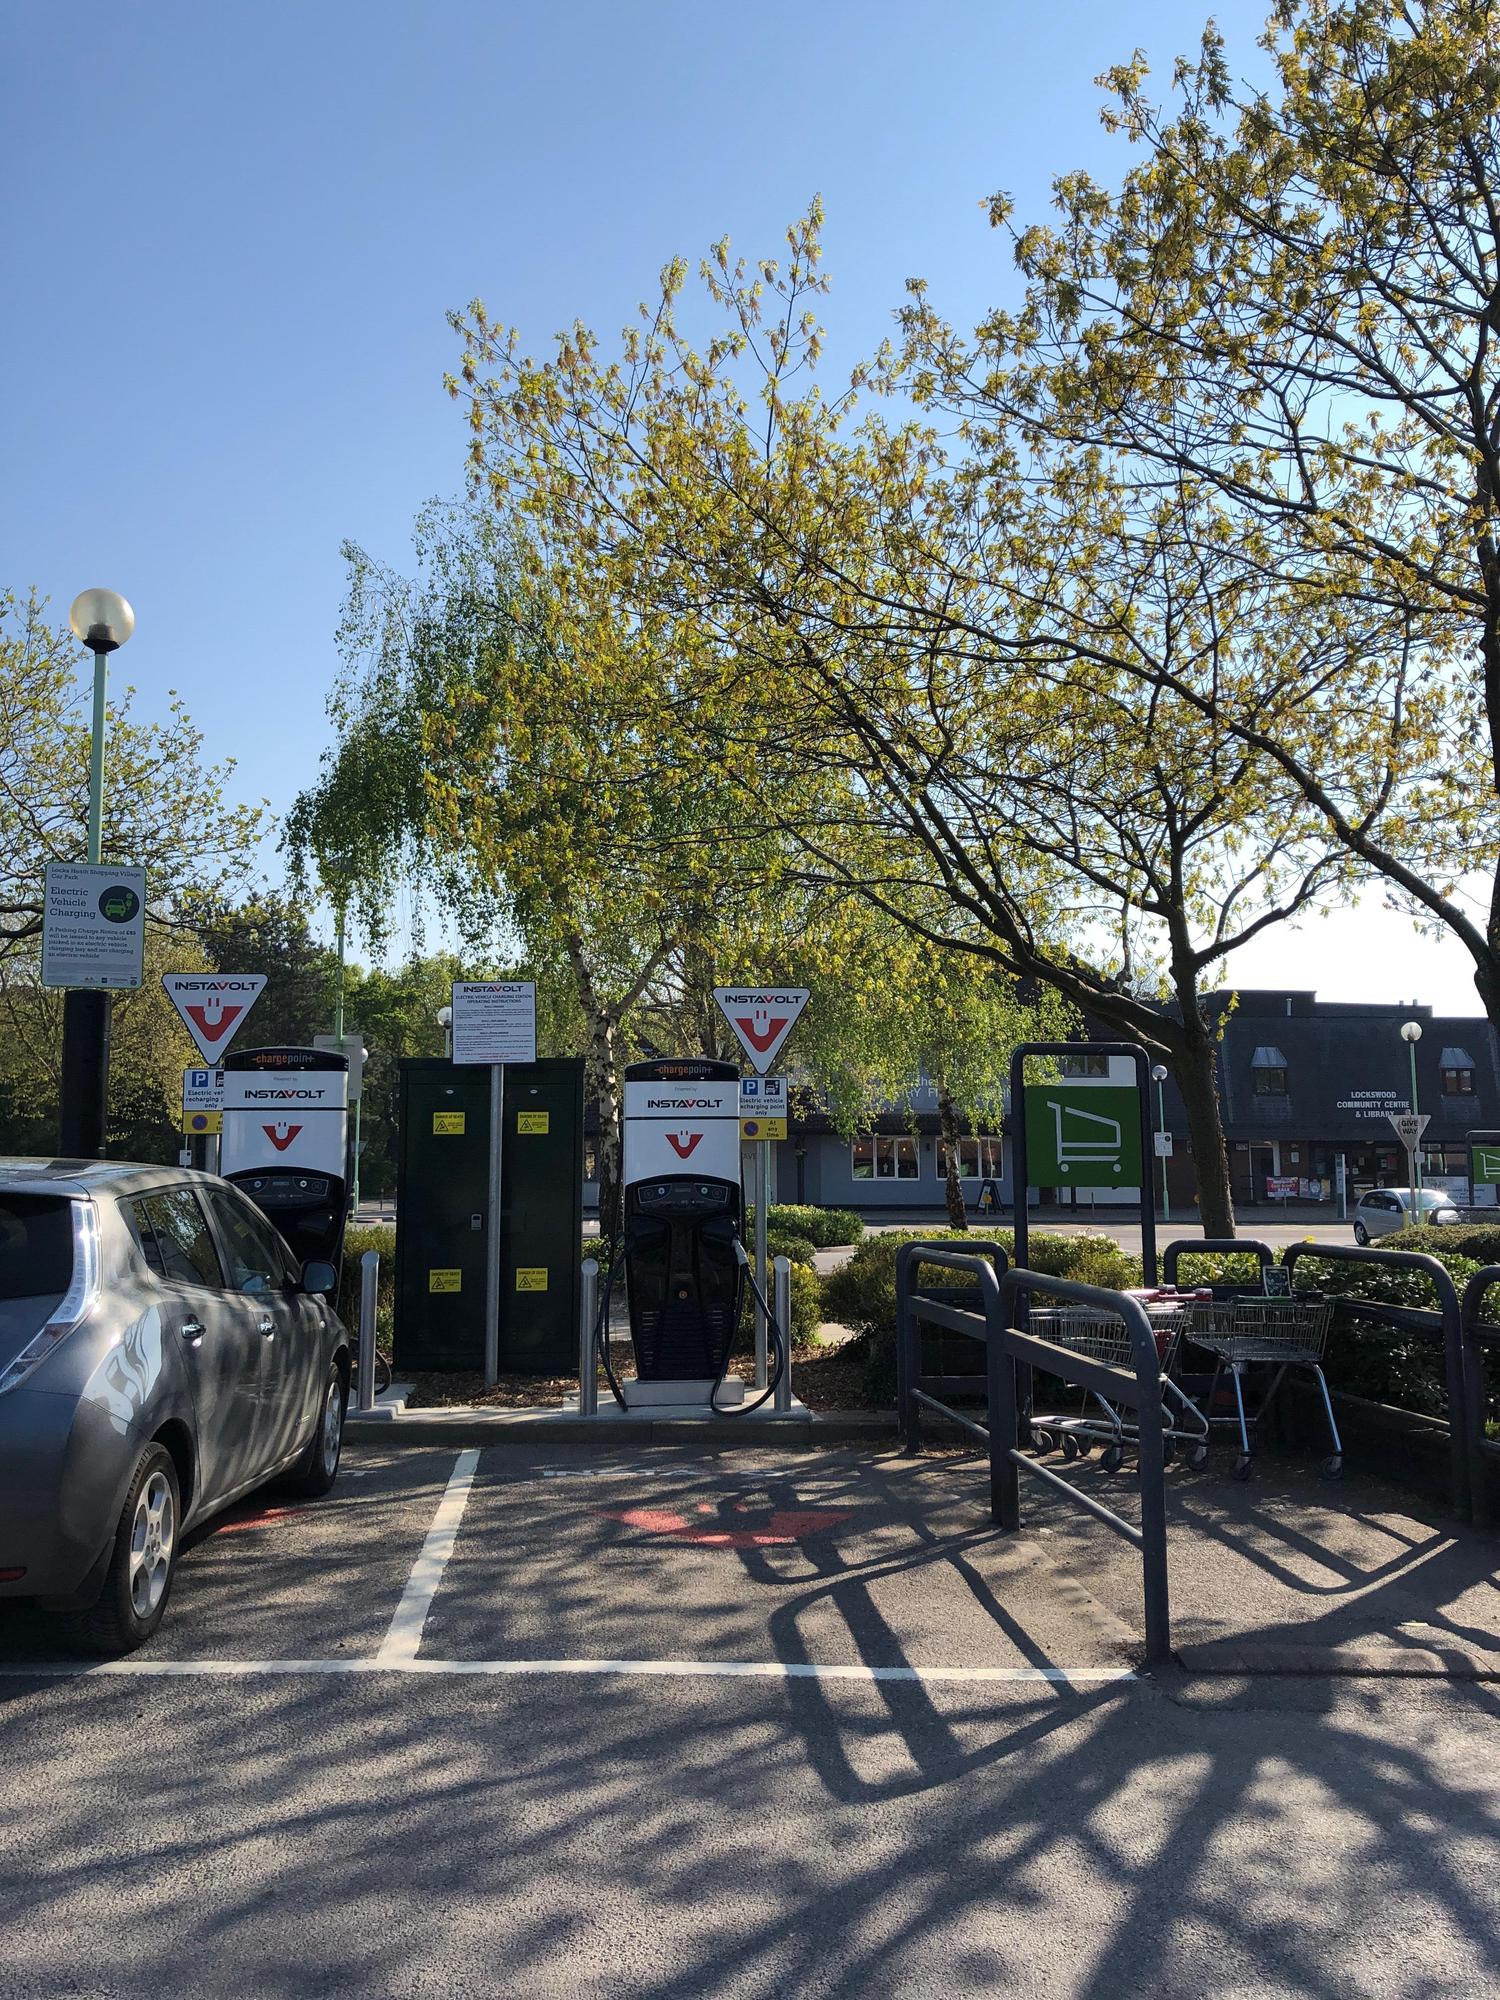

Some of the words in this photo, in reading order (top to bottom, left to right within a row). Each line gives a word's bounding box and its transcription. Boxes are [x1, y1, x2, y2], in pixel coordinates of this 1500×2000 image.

[50, 887, 89, 896] Electric
[50, 898, 86, 906] Vehicle
[50, 908, 96, 919] Charging
[174, 981, 258, 990] INSTAVOLT
[725, 995, 802, 1004] INSTAVOLT
[195, 1073, 206, 1086] P
[747, 1082, 756, 1093] P
[245, 1089, 325, 1098] INSTAVOLT
[648, 1099, 723, 1108] INSTAVOLT
